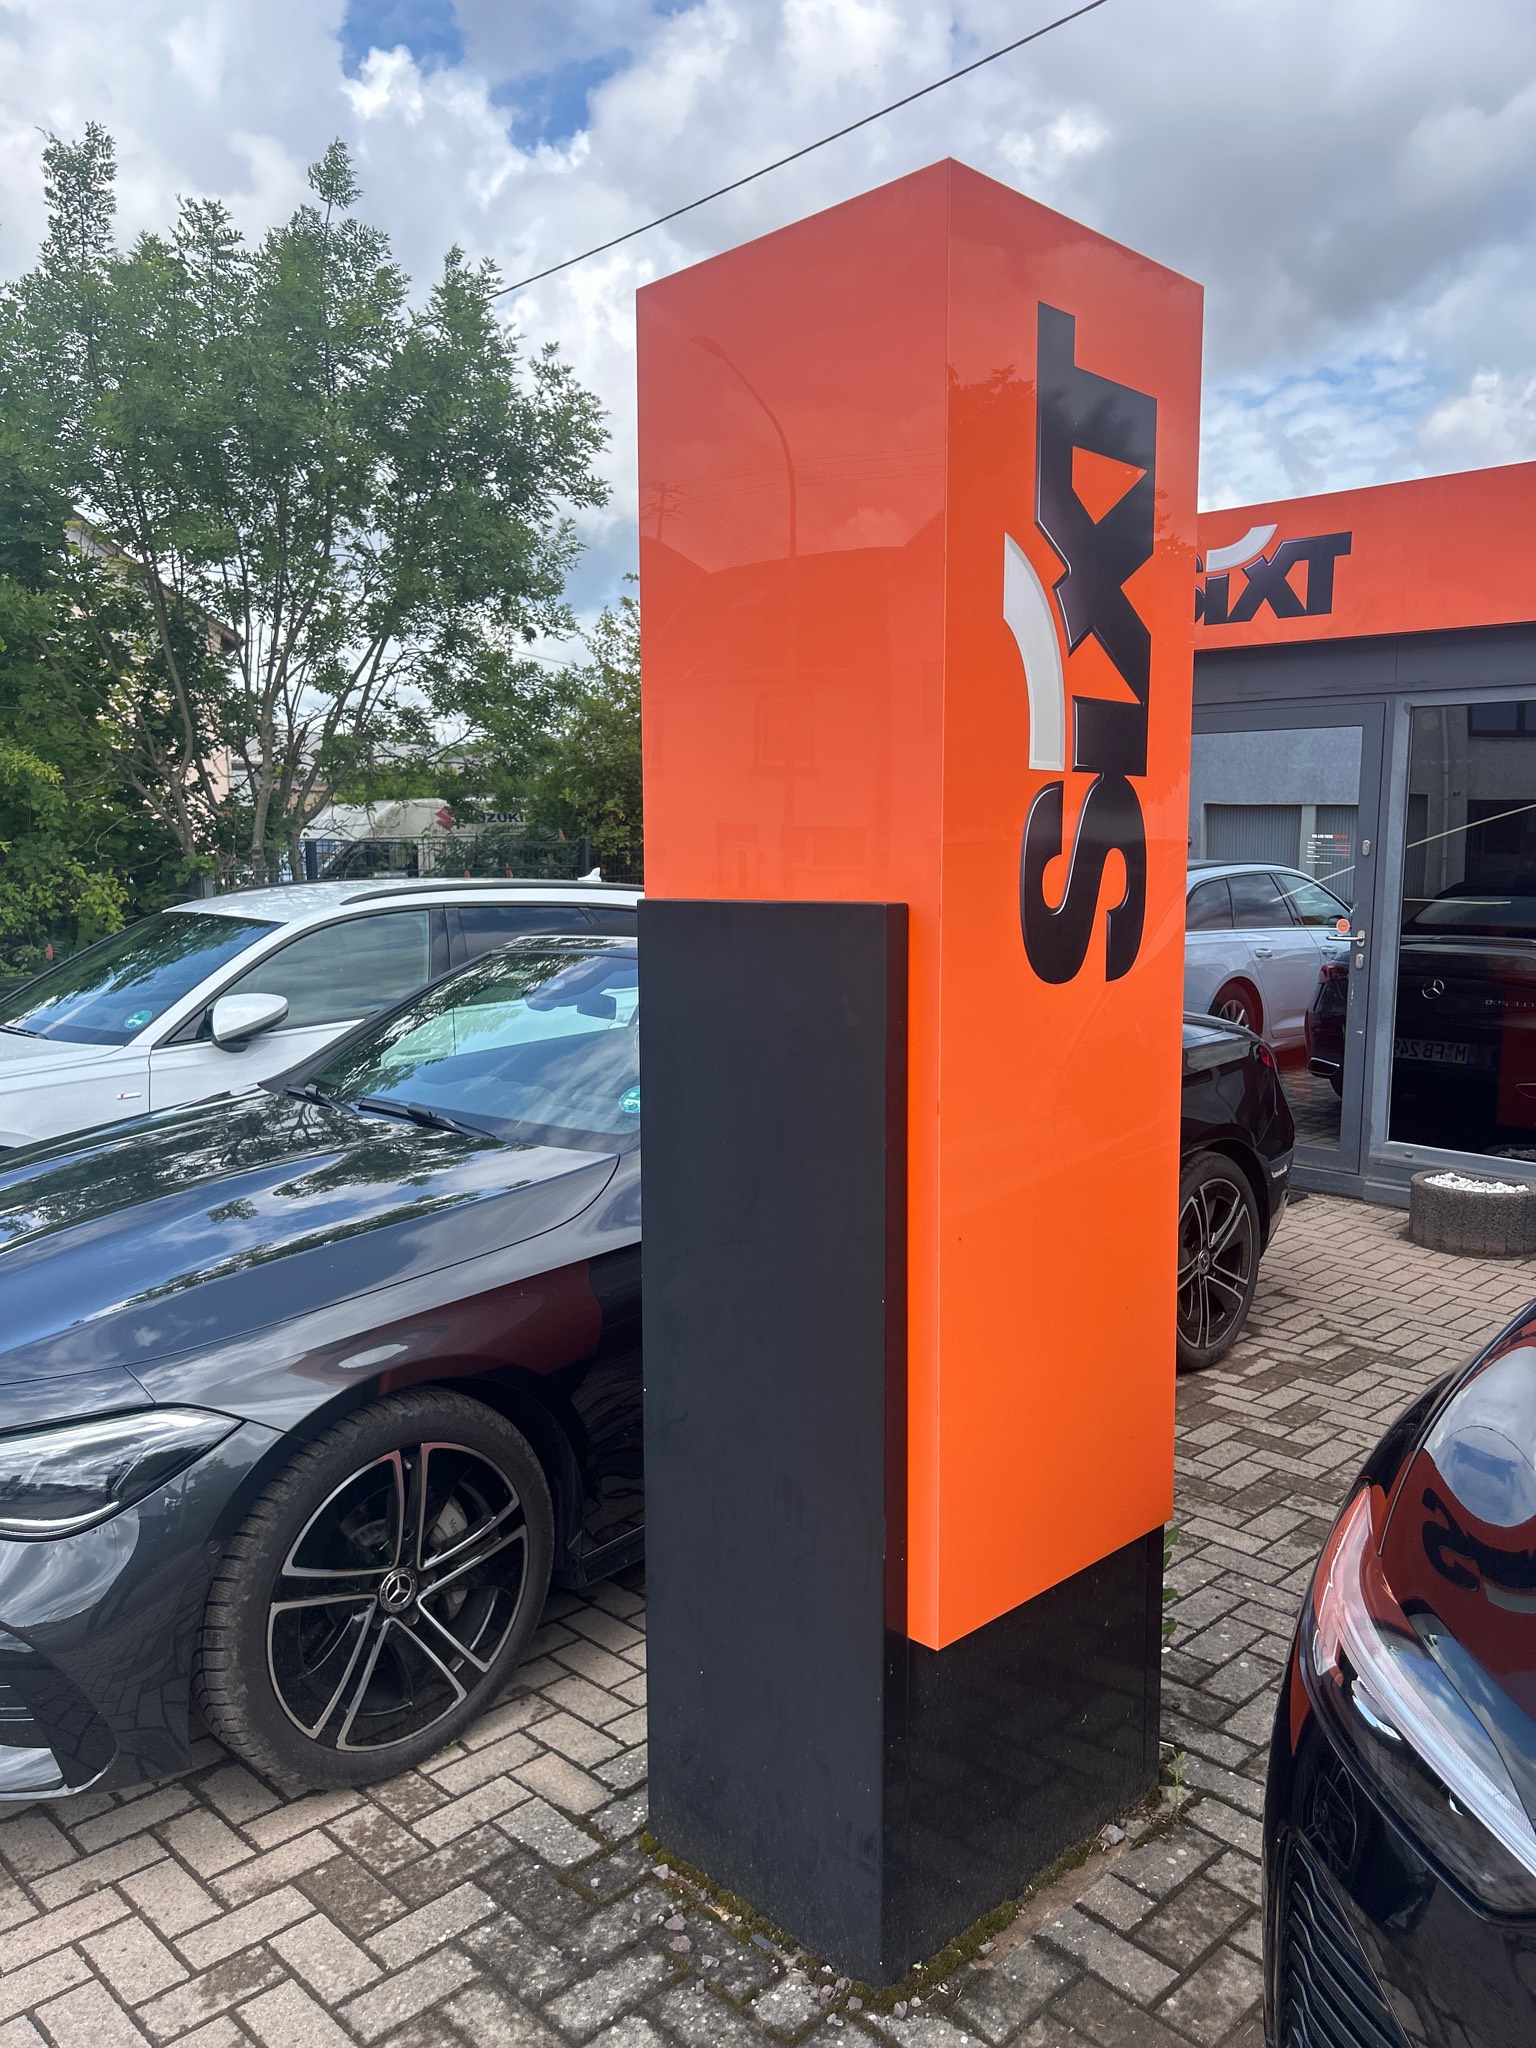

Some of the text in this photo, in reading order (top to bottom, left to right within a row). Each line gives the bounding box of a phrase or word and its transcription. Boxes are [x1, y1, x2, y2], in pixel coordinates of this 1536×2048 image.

[1195, 524, 1353, 626] IXT
[1003, 301, 1158, 984] SIXT
[479, 812, 524, 823] ZUKI
